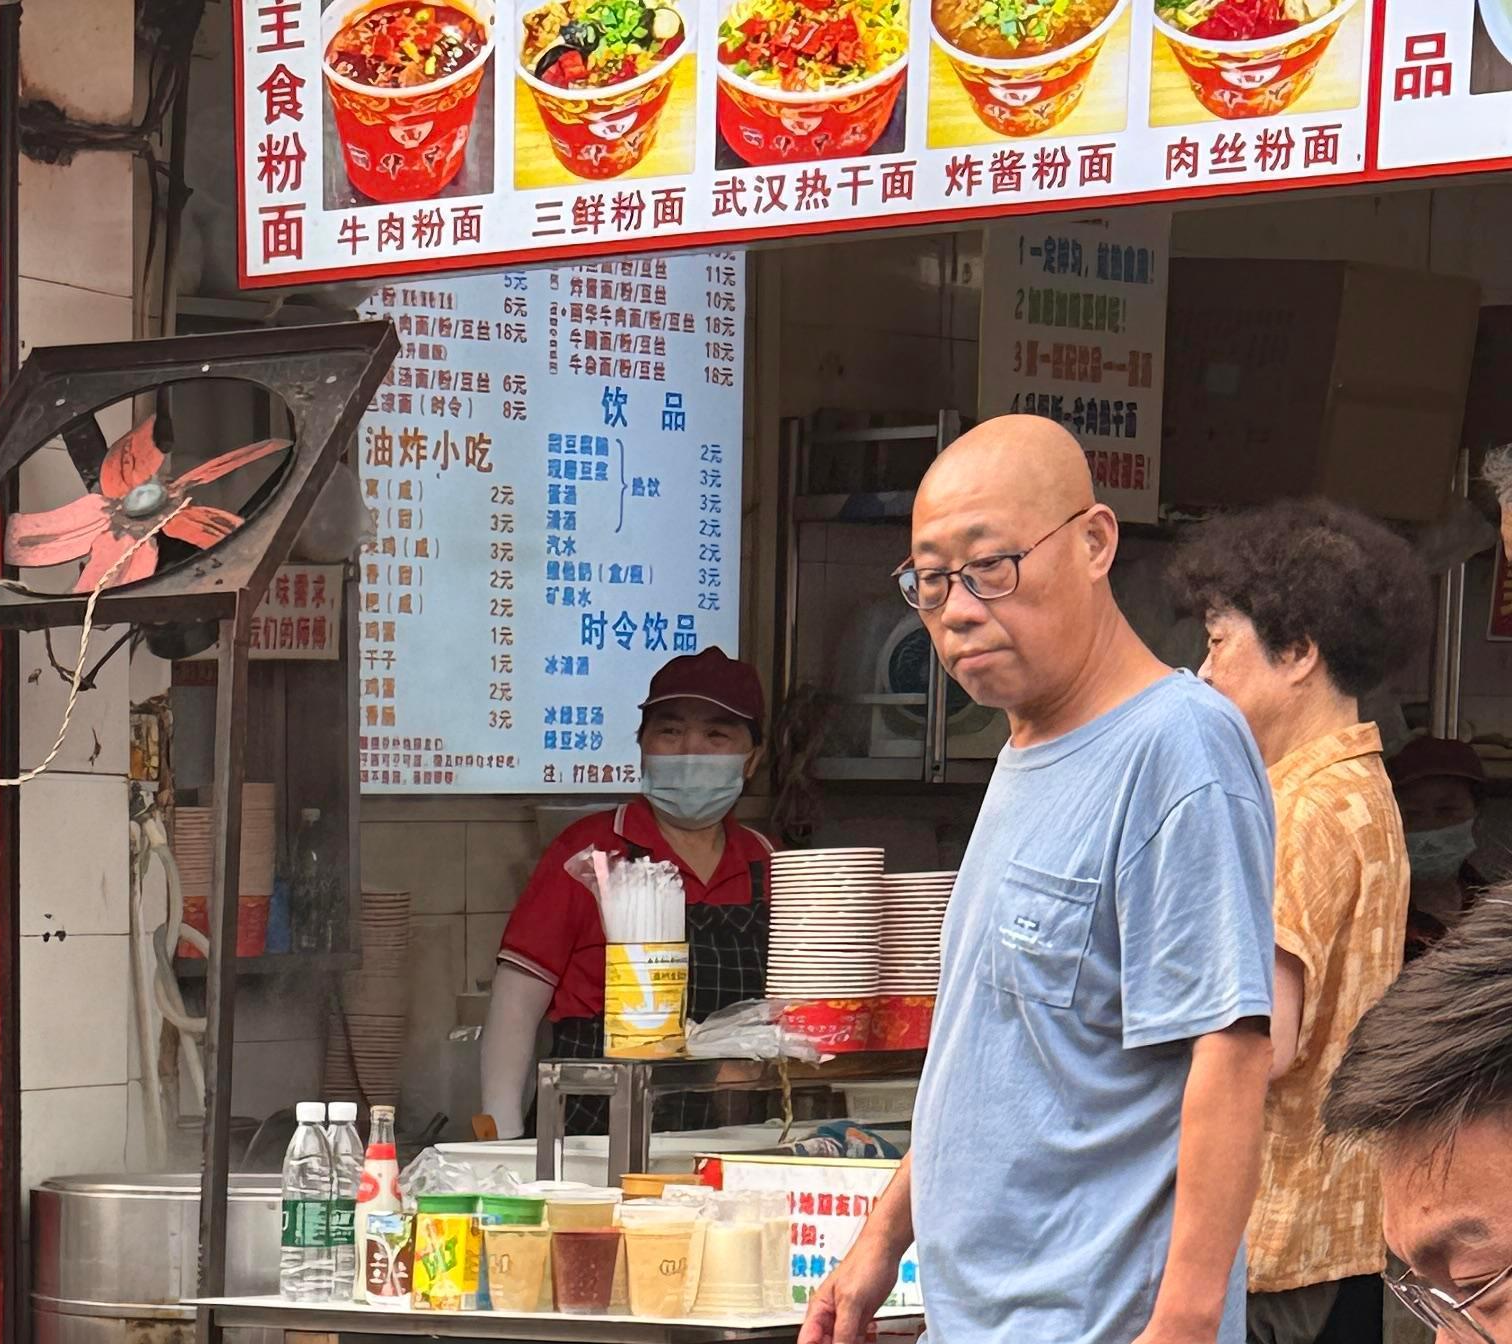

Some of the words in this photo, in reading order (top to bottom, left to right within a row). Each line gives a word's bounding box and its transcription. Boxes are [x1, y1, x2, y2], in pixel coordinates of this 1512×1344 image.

[1394, 32, 1453, 102] 品
[257, 0, 306, 262] 主食粉面
[1165, 123, 1343, 180] 肉丝粉面
[945, 142, 1117, 198] 炸酱粉面
[711, 160, 917, 216] 武汉热干面
[532, 186, 687, 238] 三鲜粉面
[337, 204, 485, 256] 牛肉粉面
[504, 297, 528, 318] 6元
[503, 375, 527, 395] 6元
[502, 401, 527, 421] 8元
[601, 386, 685, 431] 饮品
[366, 426, 493, 473] 油炸小吃
[700, 444, 722, 464] 2元
[700, 470, 722, 488] 3元
[491, 486, 514, 505] 2元
[700, 494, 722, 513] 3元
[491, 514, 514, 533] 3元
[699, 519, 721, 538] 2元
[491, 543, 514, 562] 3元
[698, 544, 721, 562] 2元
[490, 571, 514, 590] 2元
[698, 568, 721, 587] 3元
[490, 598, 514, 618] 2元
[698, 593, 720, 611] 2元
[491, 627, 514, 646] 1元
[581, 610, 697, 651] 时令饮品
[491, 655, 514, 673] 1元
[489, 682, 513, 701] 2元
[489, 710, 513, 729] 3元
